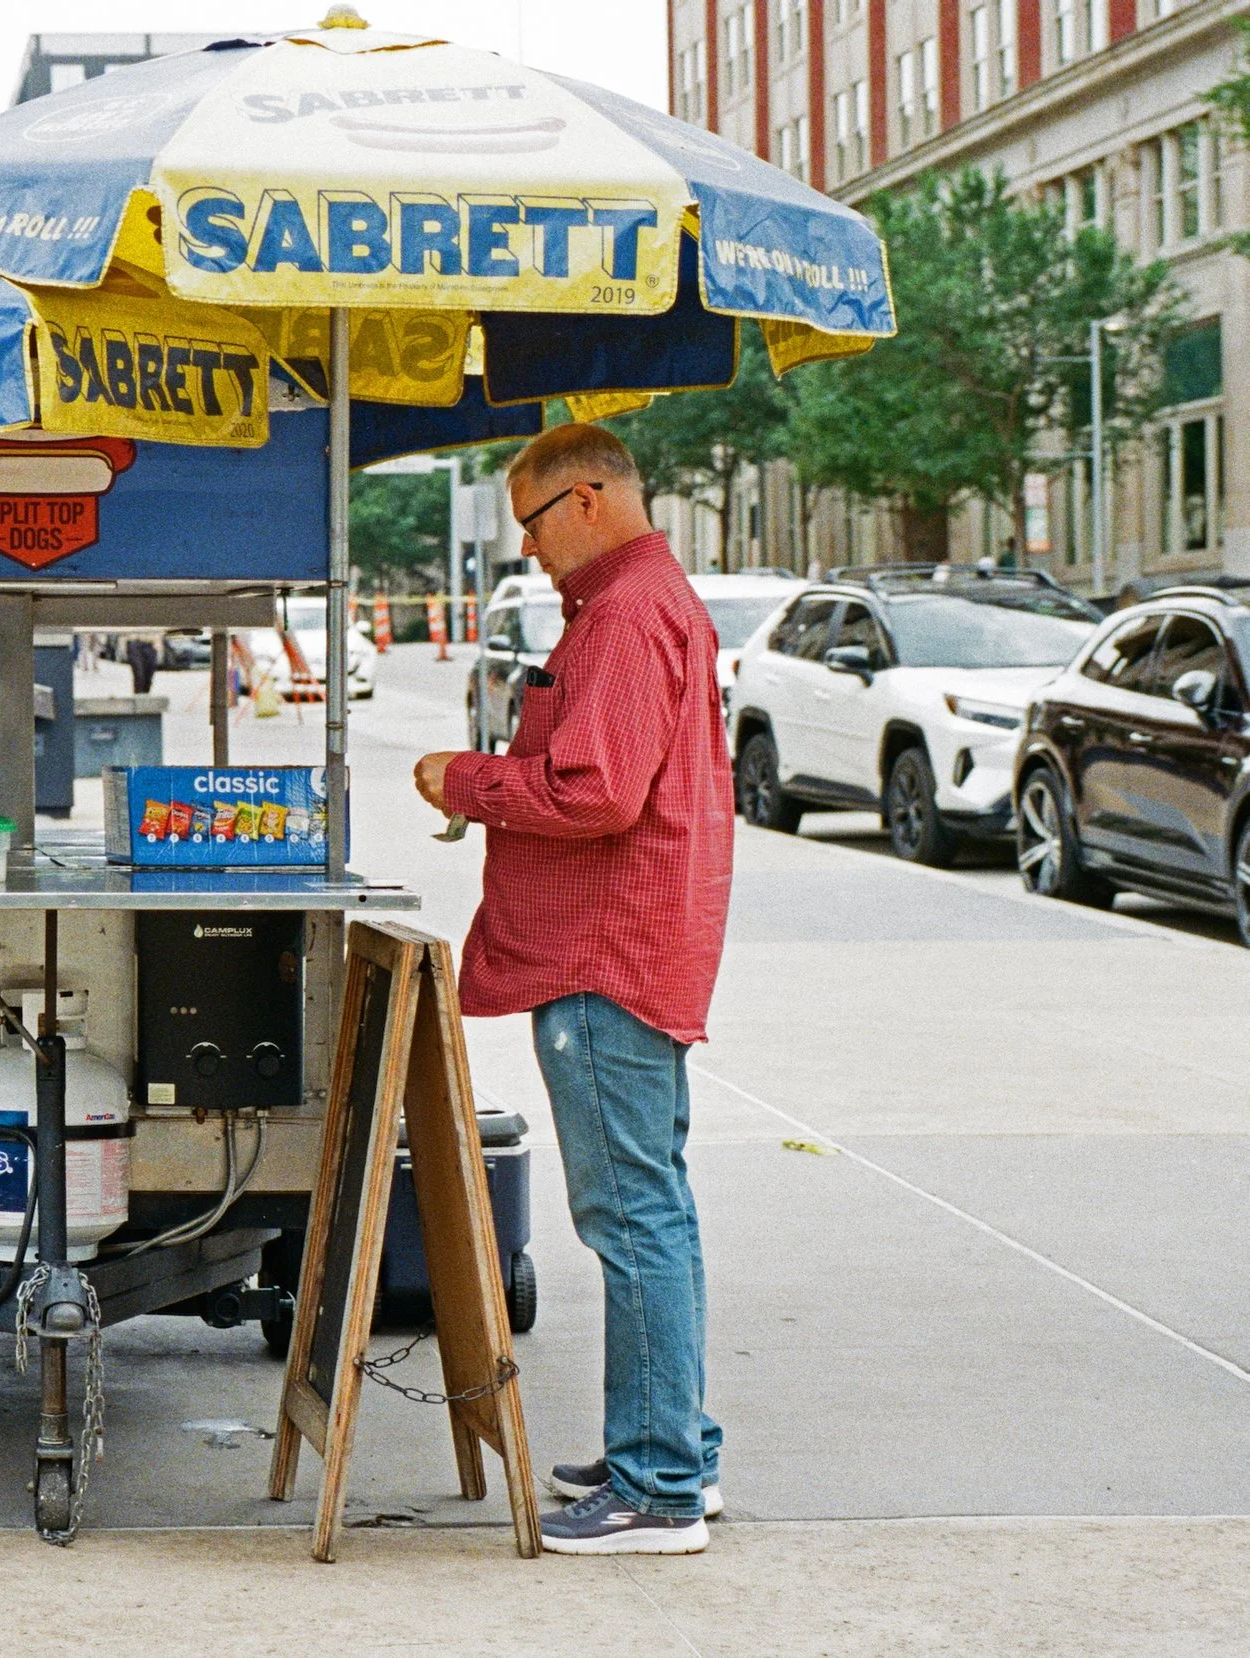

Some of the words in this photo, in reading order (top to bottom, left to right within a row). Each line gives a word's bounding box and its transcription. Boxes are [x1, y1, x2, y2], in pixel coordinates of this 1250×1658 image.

[238, 84, 526, 124] SABRETT
[6, 213, 69, 241] ROLL
[177, 186, 658, 280] SABRETT
[590, 286, 636, 305] 2019
[46, 320, 260, 417] SABRETT
[230, 423, 255, 438] 2020
[46, 501, 85, 525] TOP
[10, 527, 63, 550] DOGS
[194, 771, 280, 793] classic
